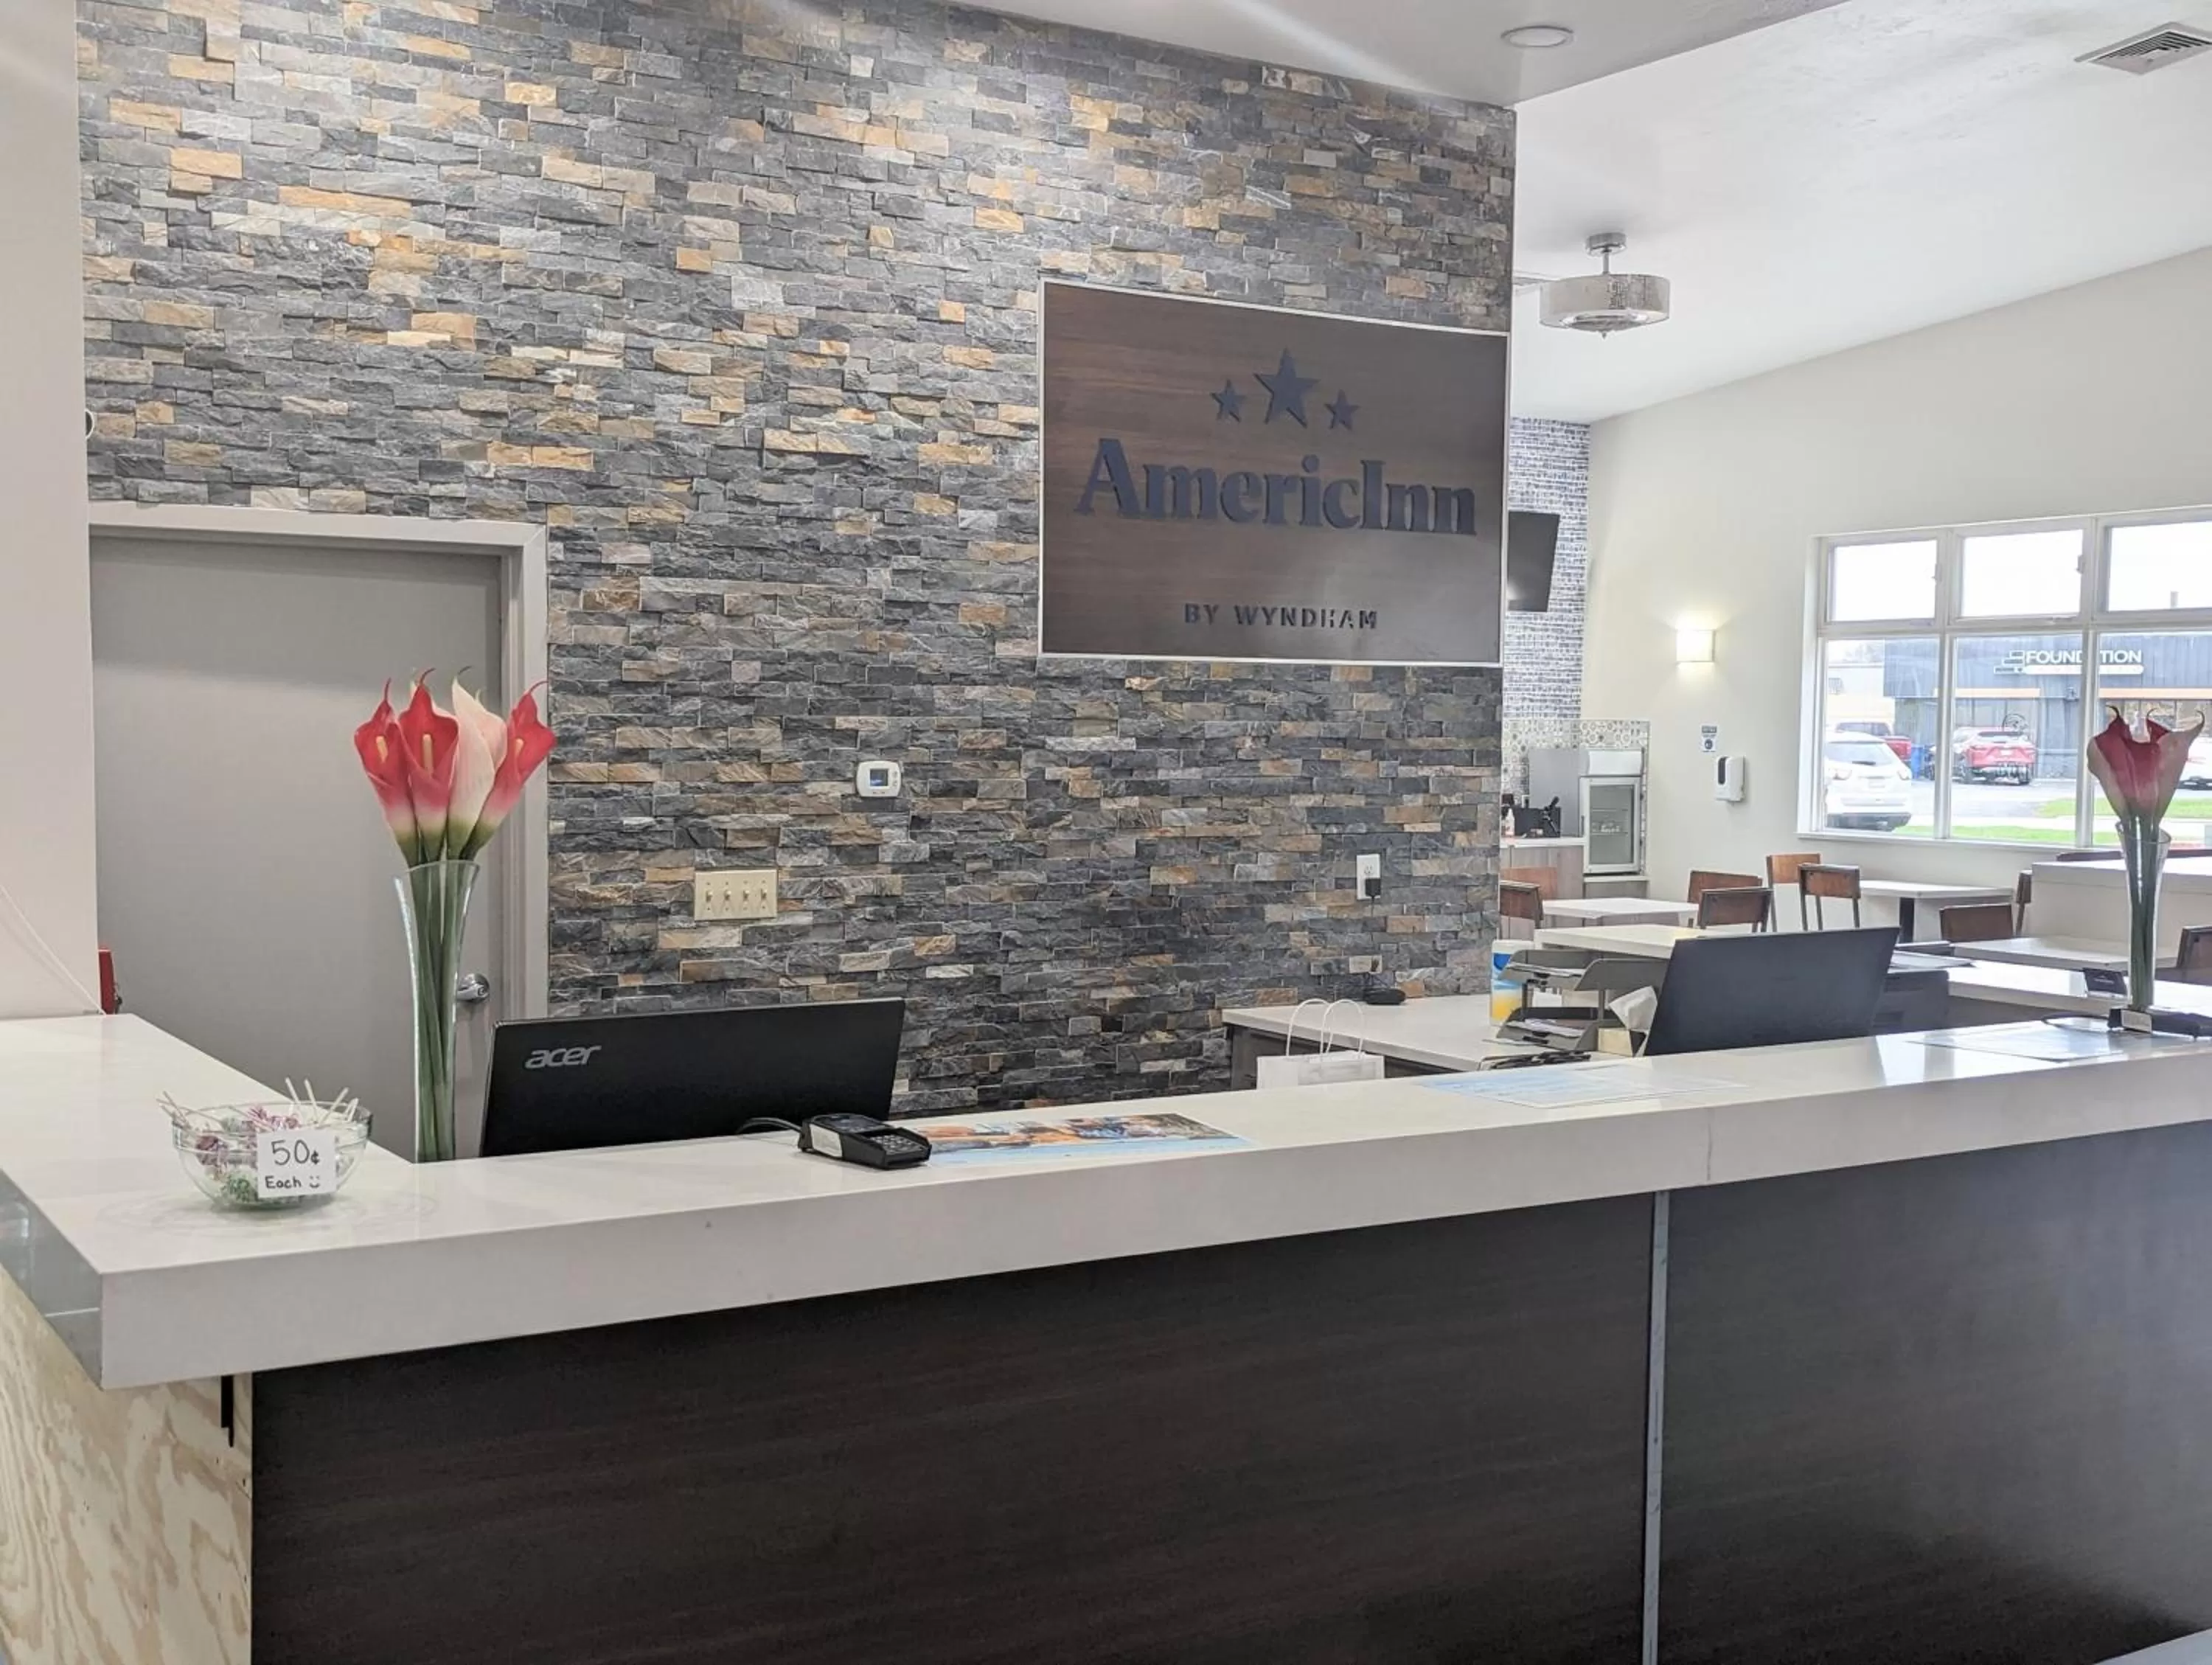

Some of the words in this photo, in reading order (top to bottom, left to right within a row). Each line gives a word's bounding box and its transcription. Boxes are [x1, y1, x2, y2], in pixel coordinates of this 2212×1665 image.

[1074, 437, 1476, 535] AmericInn
[1184, 602, 1220, 625] BY
[1234, 604, 1378, 628] WYNDHAM
[2025, 650, 2142, 664] FOUNDTION
[525, 1046, 602, 1068] acer
[271, 1139, 320, 1165] 50¢
[265, 1175, 302, 1189] Each
